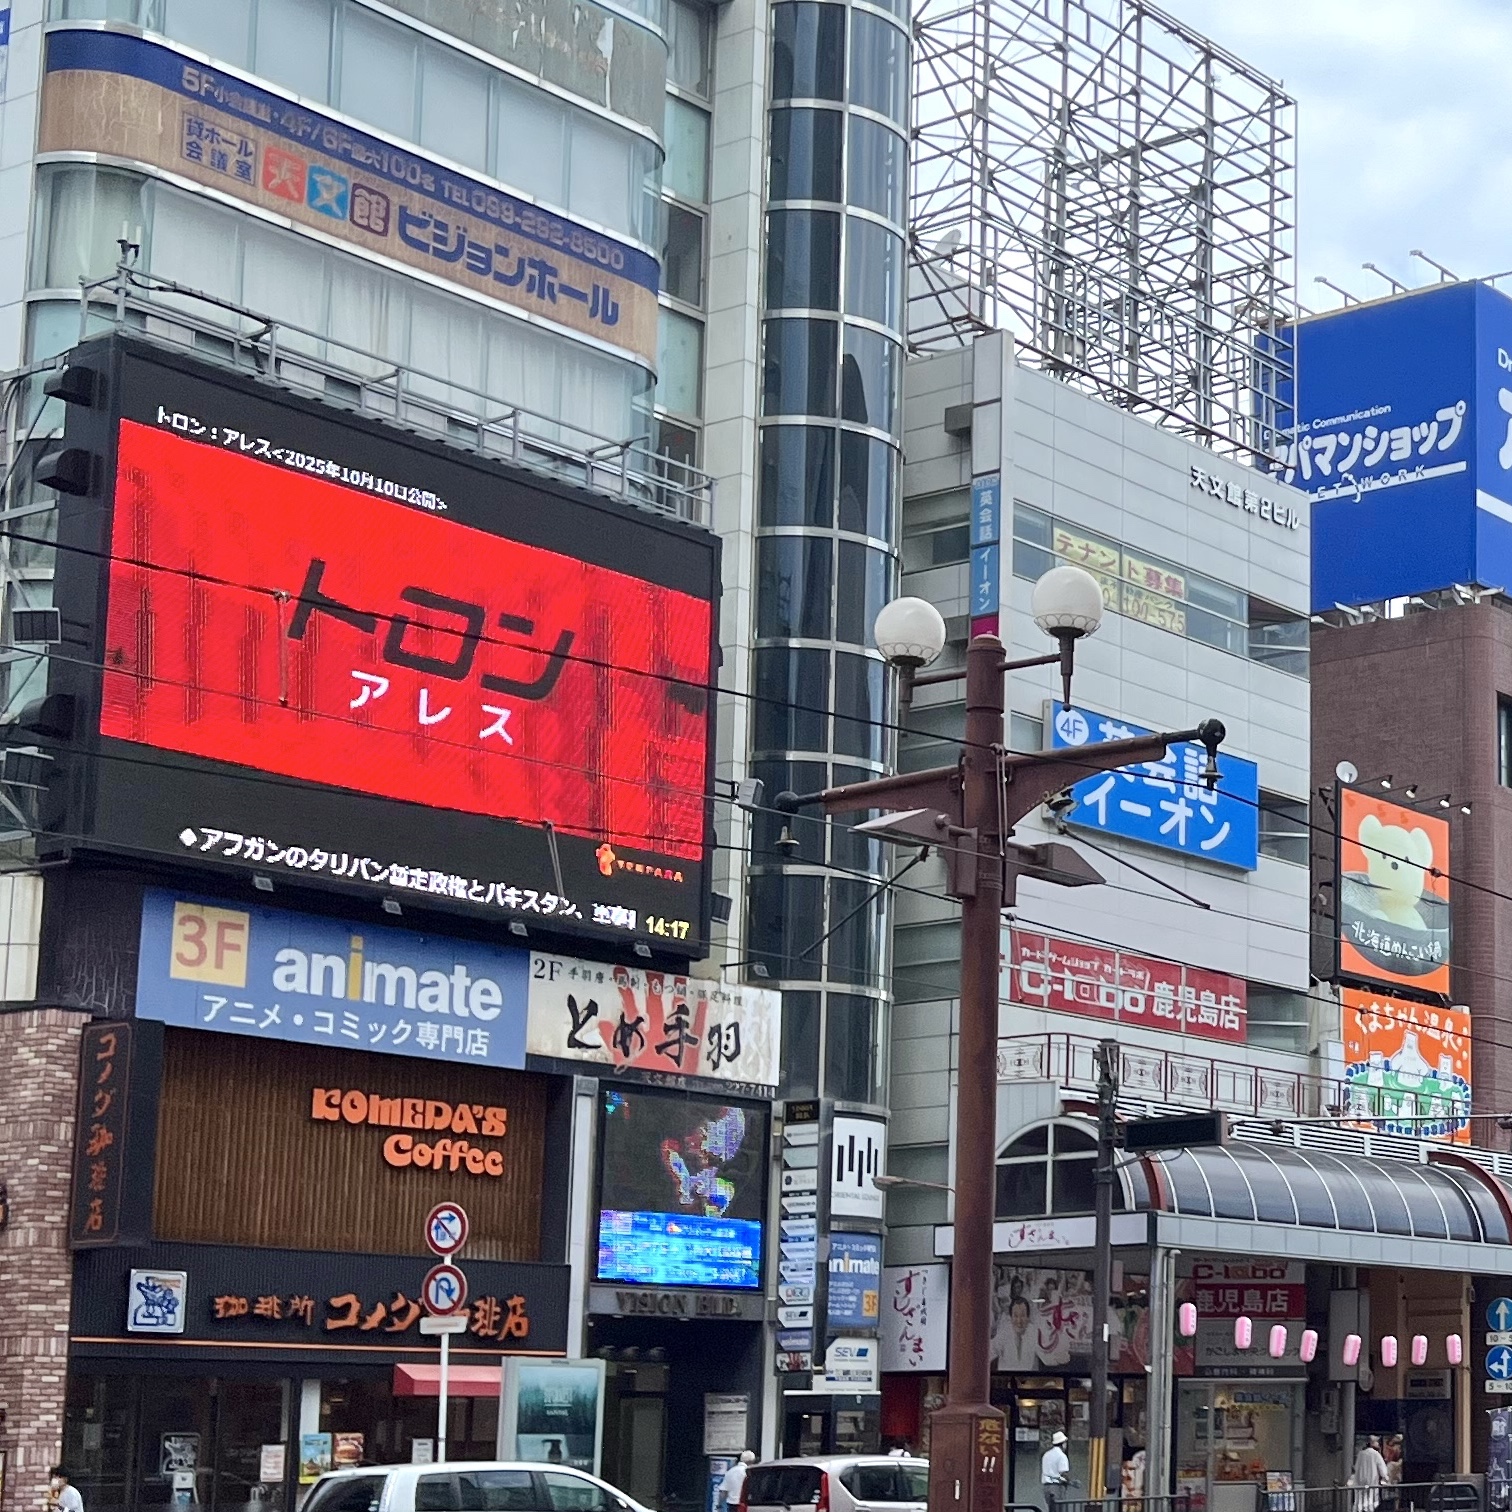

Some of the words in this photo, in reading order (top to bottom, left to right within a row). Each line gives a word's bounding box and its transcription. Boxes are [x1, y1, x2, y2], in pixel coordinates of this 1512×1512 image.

[186, 117, 254, 158] 貸ホール
[186, 140, 252, 182] 会議室
[399, 204, 620, 327] ビジョンホール
[1312, 404, 1392, 430] Communication
[979, 489, 993, 541] 英会話
[1190, 465, 1301, 531] 天文館第2ビル
[979, 547, 992, 612] イーオン
[1056, 532, 1184, 599] テナント募集
[287, 557, 576, 700] トロン
[348, 670, 515, 746] アレス
[1060, 716, 1084, 740] 4F
[1083, 775, 1231, 851] イーオン
[175, 914, 247, 971] 3F
[646, 914, 691, 941] 14:17
[272, 935, 503, 1022] animate
[533, 957, 564, 982] 2F
[202, 994, 490, 1057] アニメ・コミック専門店
[566, 993, 741, 1071] とめ手羽
[1152, 980, 1241, 1032] 鹿児島店
[1354, 1000, 1460, 1052] くまちゃん温泉
[311, 1086, 508, 1139] KOMEDA'S
[381, 1134, 505, 1179] Coffee
[1196, 1288, 1290, 1313] 鹿児島店
